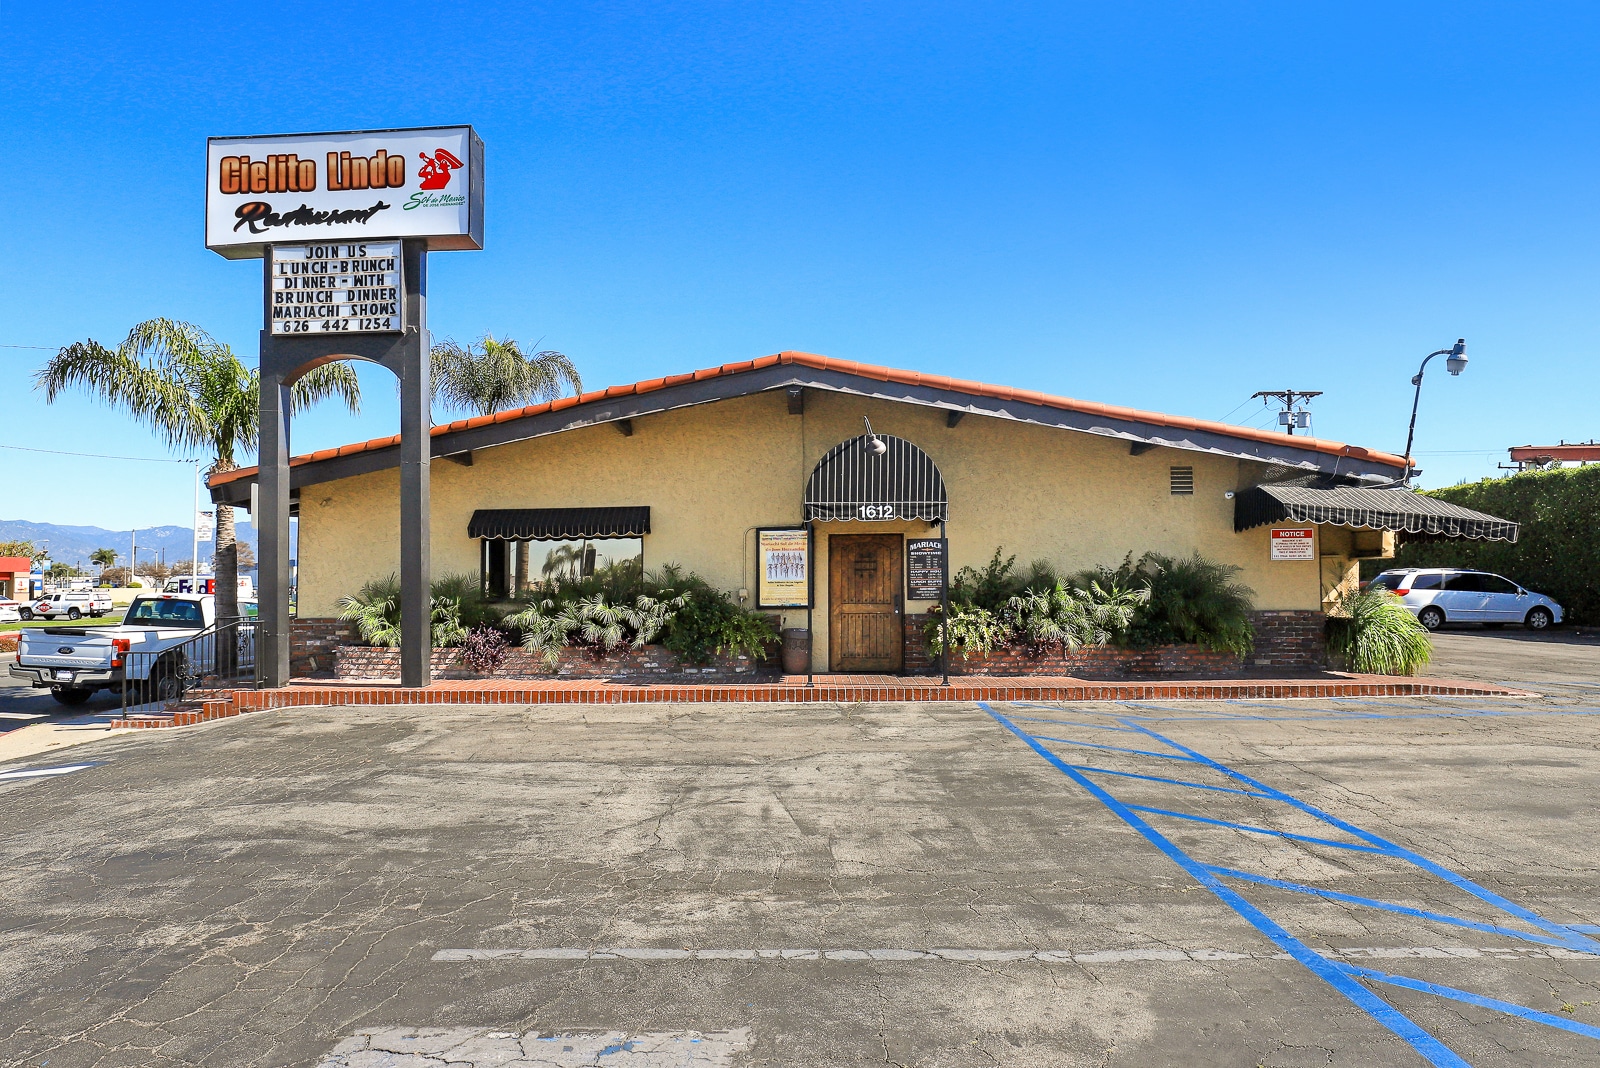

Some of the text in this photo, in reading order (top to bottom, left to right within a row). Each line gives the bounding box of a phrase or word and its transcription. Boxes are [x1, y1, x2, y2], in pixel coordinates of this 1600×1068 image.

[219, 149, 405, 194] Cielito Lindo
[403, 192, 433, 210] Sol
[439, 194, 465, 203] Mexico
[233, 201, 390, 234] Restaurant
[306, 245, 367, 259] JOIN US
[284, 277, 336, 288] DINNER
[354, 274, 385, 286] WITH
[275, 288, 396, 303] BRUNCH DINNER
[273, 303, 396, 318] MARIACHI SHOWS
[283, 318, 391, 332] 626 442 1254
[859, 505, 893, 518] 1612
[910, 541, 942, 551] MARIACH
